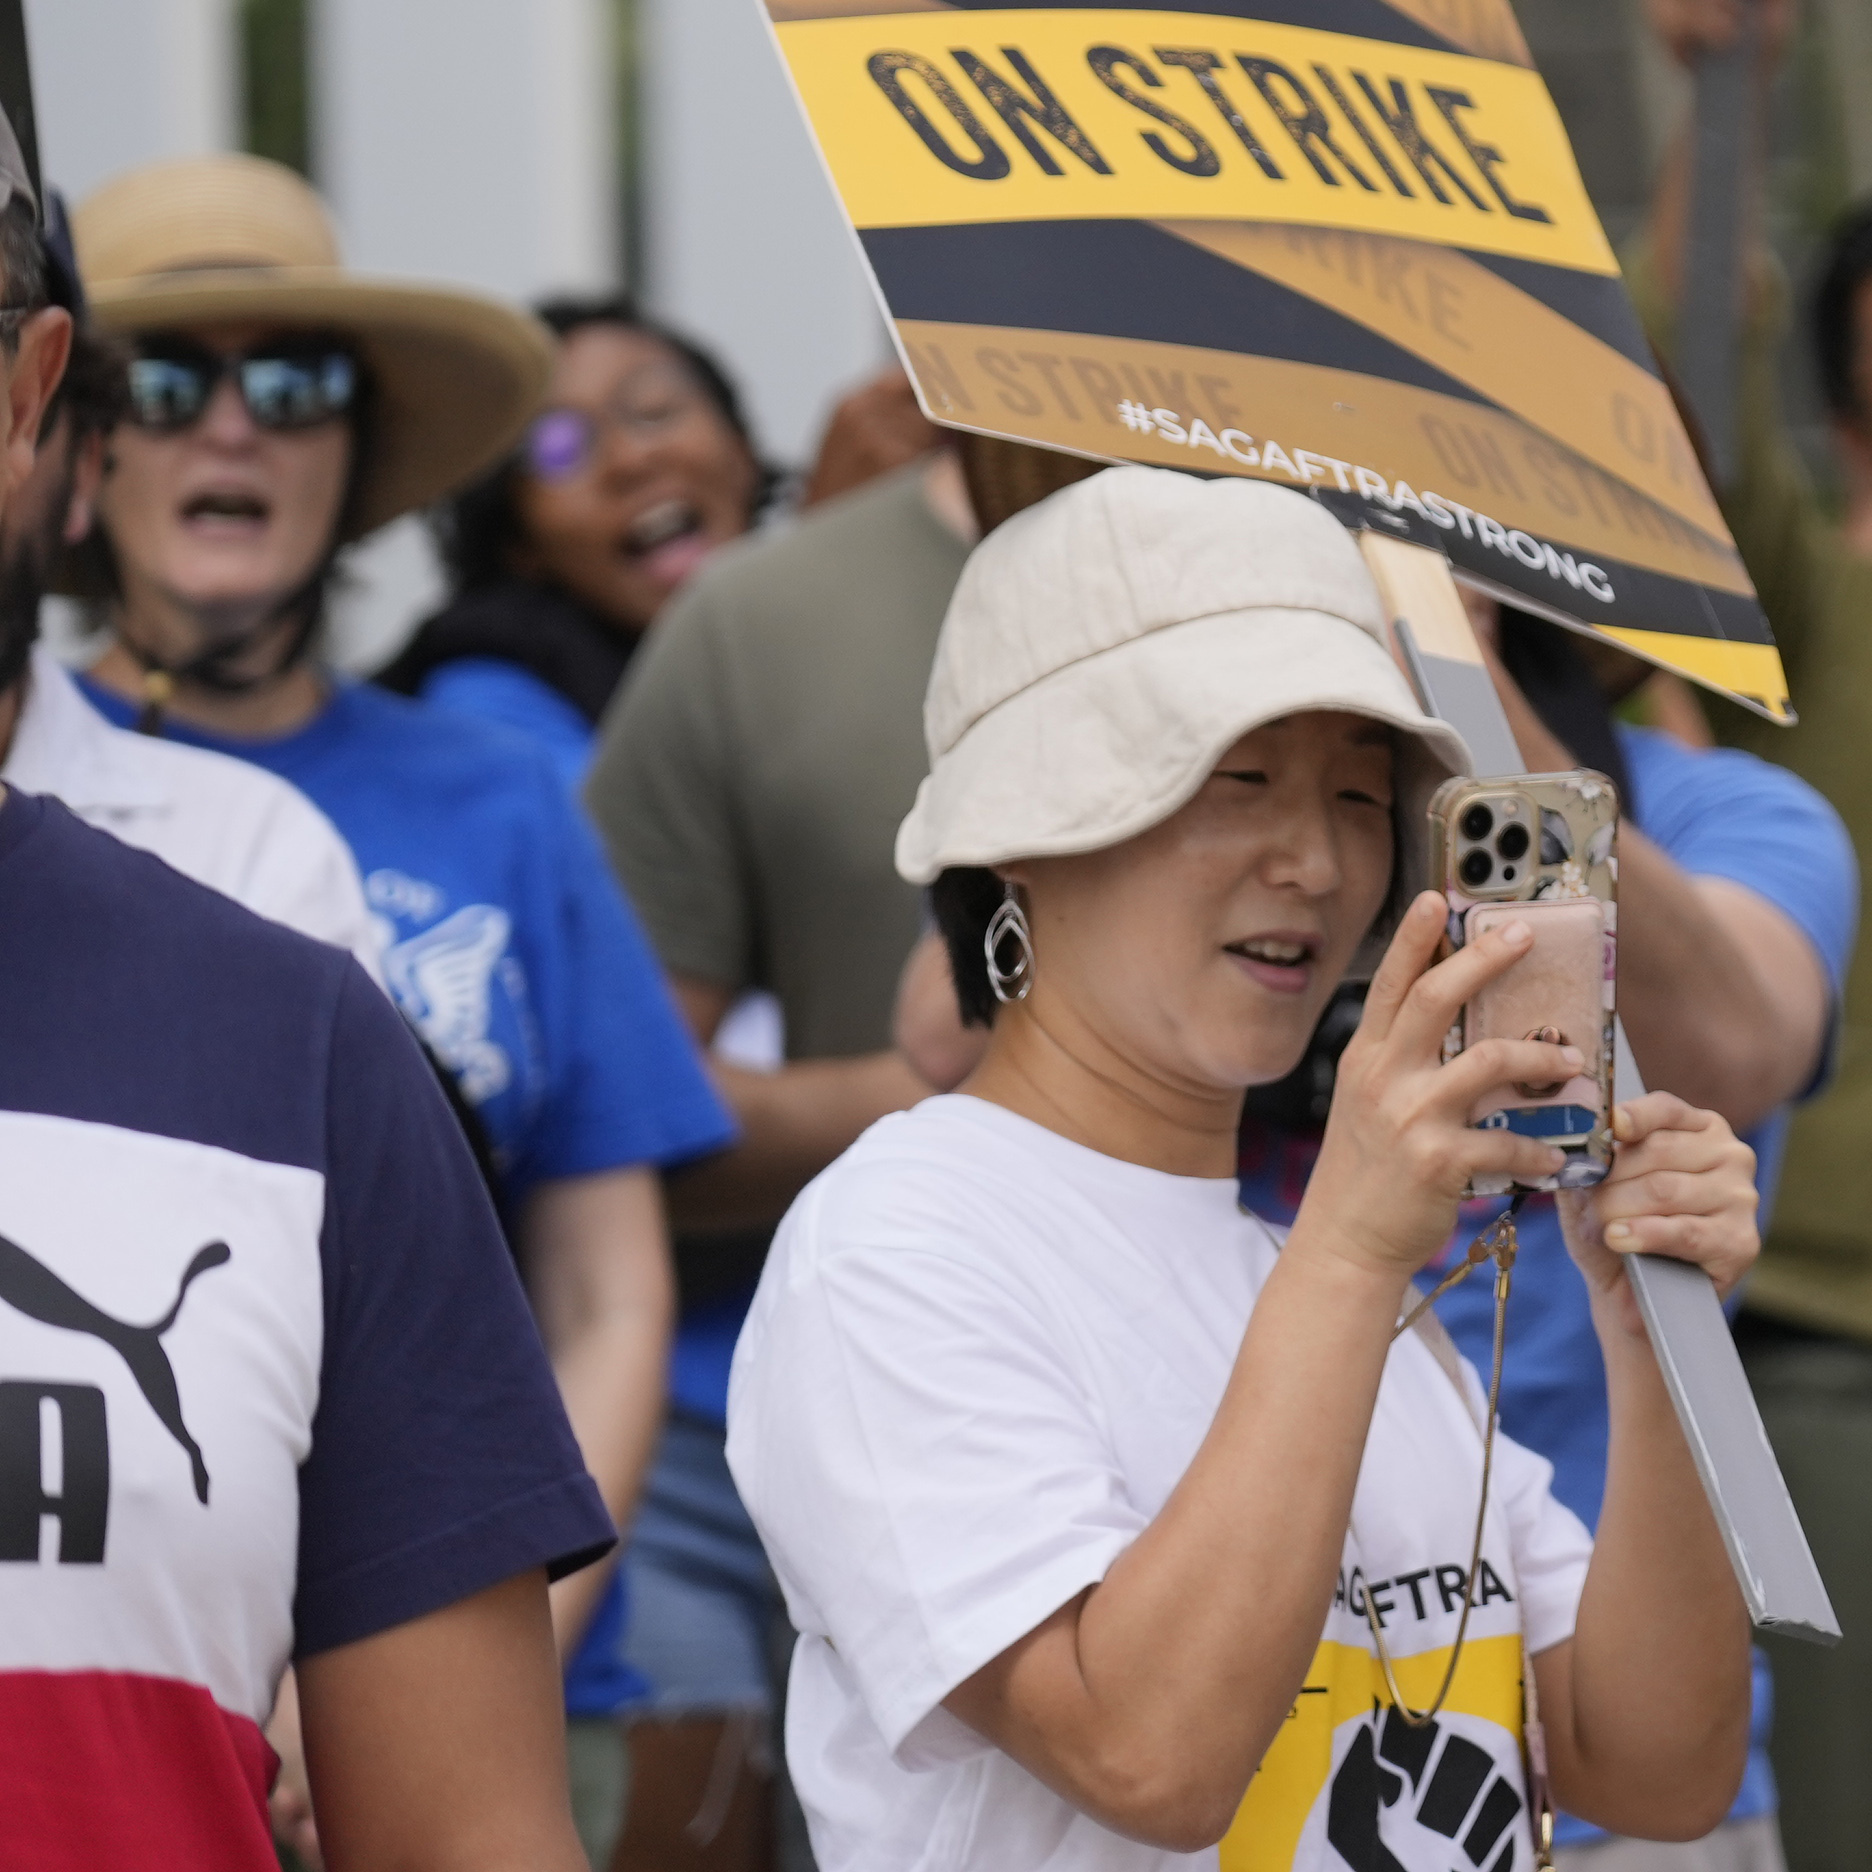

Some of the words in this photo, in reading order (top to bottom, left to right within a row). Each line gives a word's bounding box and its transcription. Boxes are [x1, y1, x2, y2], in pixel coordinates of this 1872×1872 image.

[866, 45, 1117, 181] ON
[1084, 40, 1559, 226] STRIKE
[1117, 396, 1618, 605] #SAGAFTRASTRONG
[1418, 411, 1528, 504] ON
